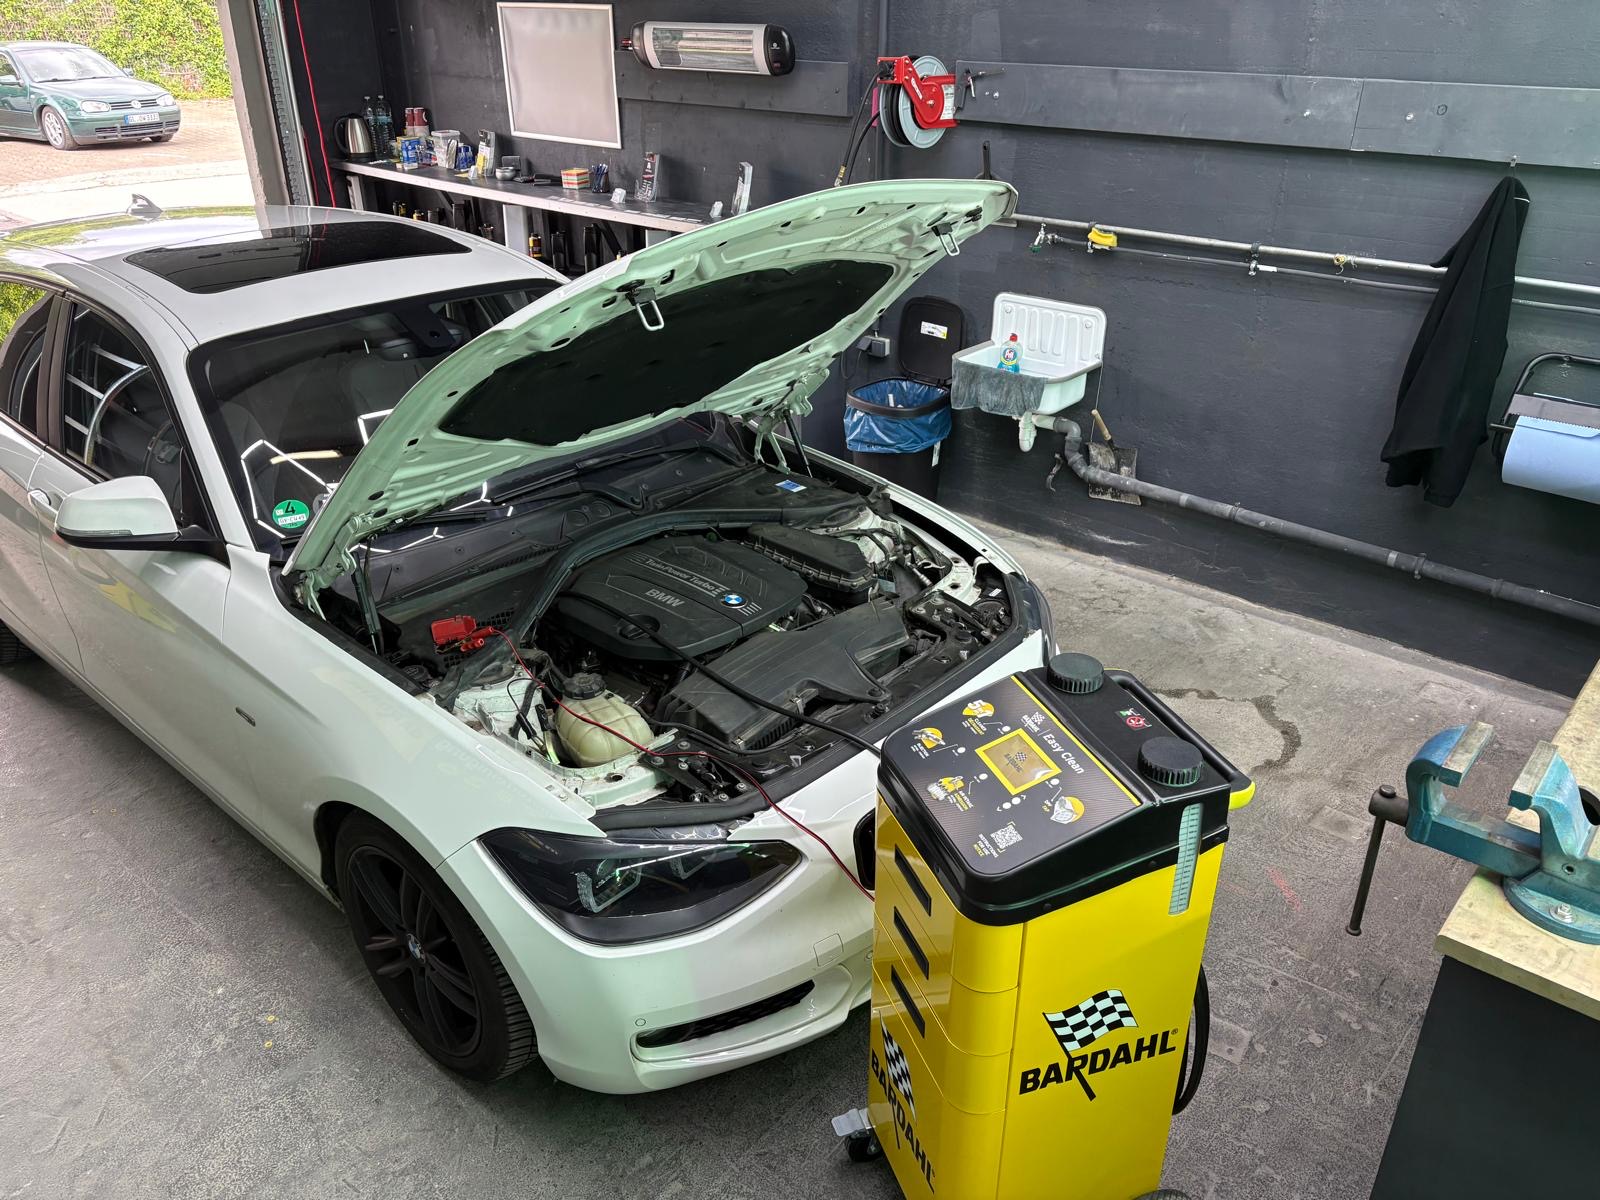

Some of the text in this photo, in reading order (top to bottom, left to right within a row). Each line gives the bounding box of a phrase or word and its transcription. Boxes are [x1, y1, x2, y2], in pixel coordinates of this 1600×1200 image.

[285, 501, 296, 513] 4
[644, 588, 686, 607] BMW
[689, 575, 715, 591] Turbo
[1042, 733, 1065, 752] Easy
[1061, 752, 1085, 774] Clean
[1019, 1028, 1178, 1102] BARDAHL
[871, 1048, 935, 1195] BARDAHL
